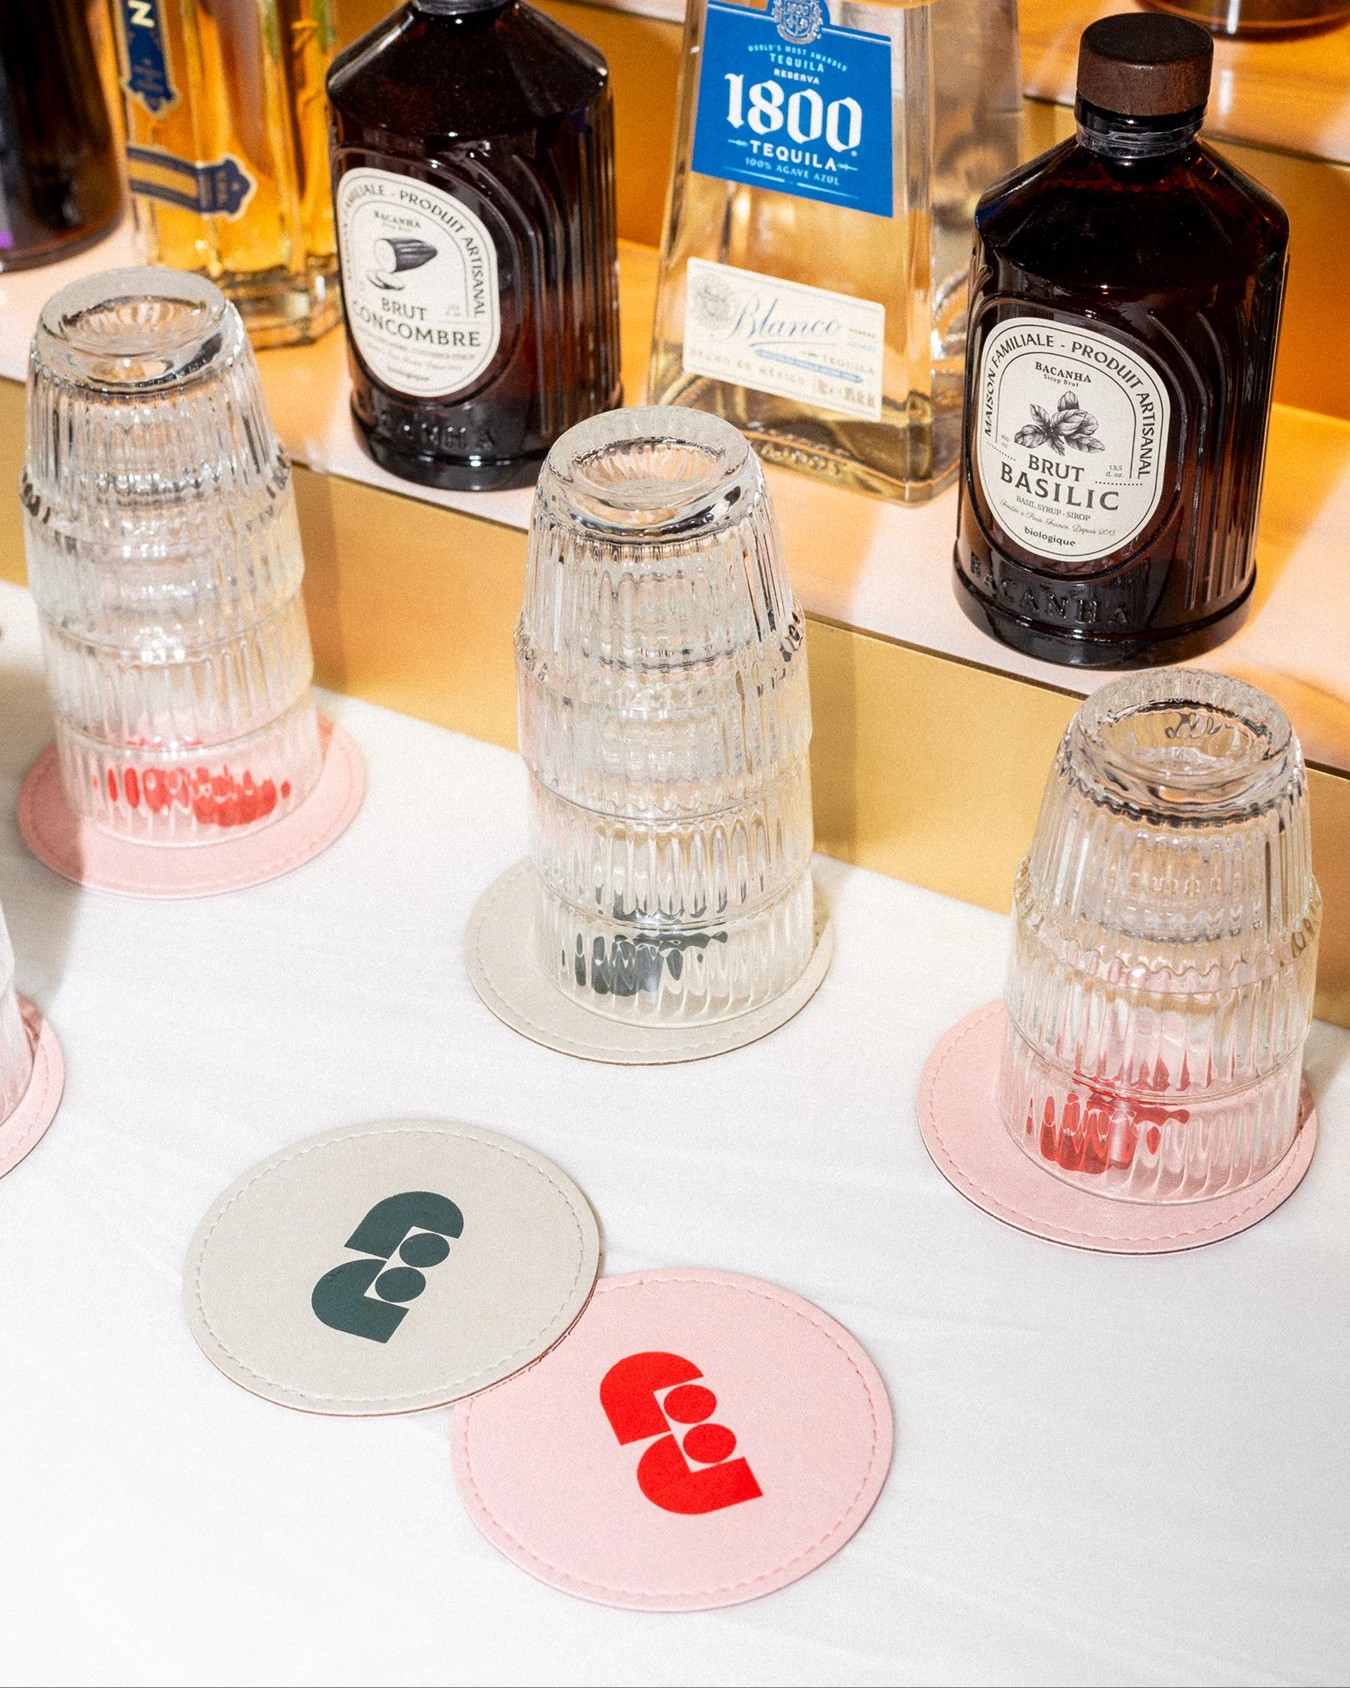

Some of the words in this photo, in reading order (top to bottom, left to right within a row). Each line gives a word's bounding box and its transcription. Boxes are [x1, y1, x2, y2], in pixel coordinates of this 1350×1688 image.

[769, 53, 824, 73] TEQUILA
[785, 45, 807, 56] MOST
[810, 51, 848, 72] AWARDED
[773, 68, 820, 85] RESERVA
[724, 73, 863, 153] 1800
[749, 140, 838, 172] TEQUILA
[745, 157, 772, 171] 100%
[776, 164, 810, 179] AGAVE
[813, 172, 840, 186] AZUL
[399, 190, 465, 233] PRODUIT
[462, 237, 486, 318] ARTISANAL
[381, 297, 428, 321] BRUT
[727, 290, 841, 340] Blanco
[1035, 361, 1092, 383] BACANHA
[1043, 373, 1062, 385] Sirop
[1063, 379, 1079, 387] Brut
[984, 367, 997, 437] MAISON
[991, 333, 1055, 369] FAMILIALE
[1071, 340, 1145, 389] PRODUIT
[1135, 392, 1156, 480] ARTISANAL
[1028, 453, 1085, 482] BRUT
[1000, 461, 1120, 511] BASILIC
[1016, 495, 1037, 509] BASIL
[1037, 503, 1062, 516] SYRUP
[1066, 511, 1091, 521] SIROP
[1024, 526, 1076, 547] biologique
